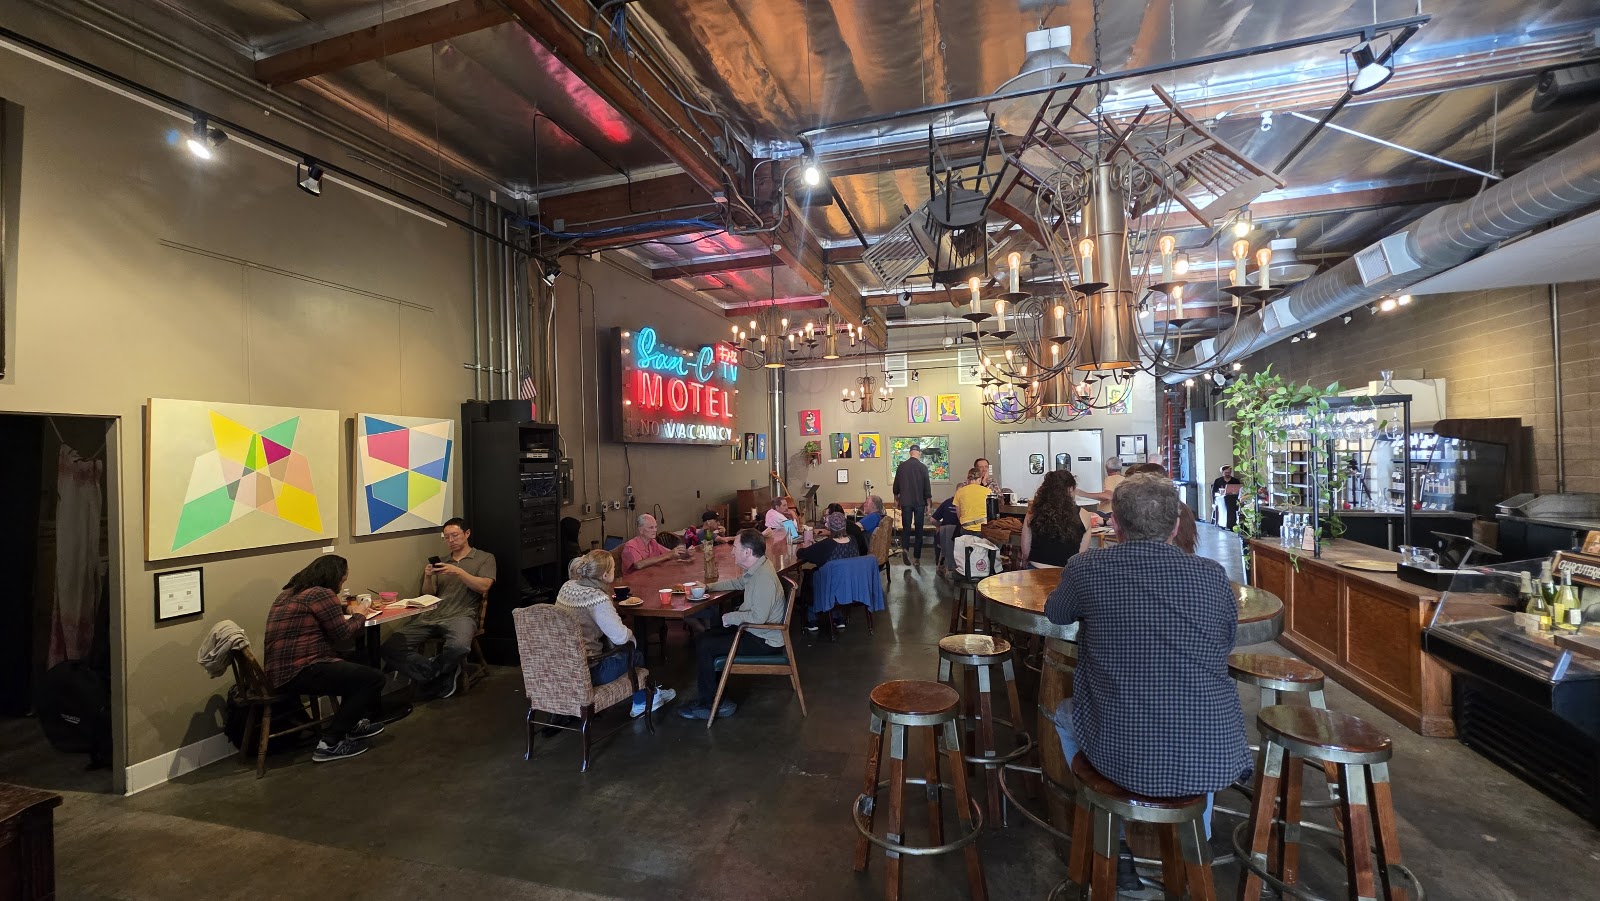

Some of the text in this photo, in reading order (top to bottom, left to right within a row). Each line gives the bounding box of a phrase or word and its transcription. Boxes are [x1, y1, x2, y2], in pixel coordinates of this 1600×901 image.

[719, 361, 738, 383] TV
[636, 370, 733, 418] MOTEL
[641, 419, 732, 440] NO VACANCY
